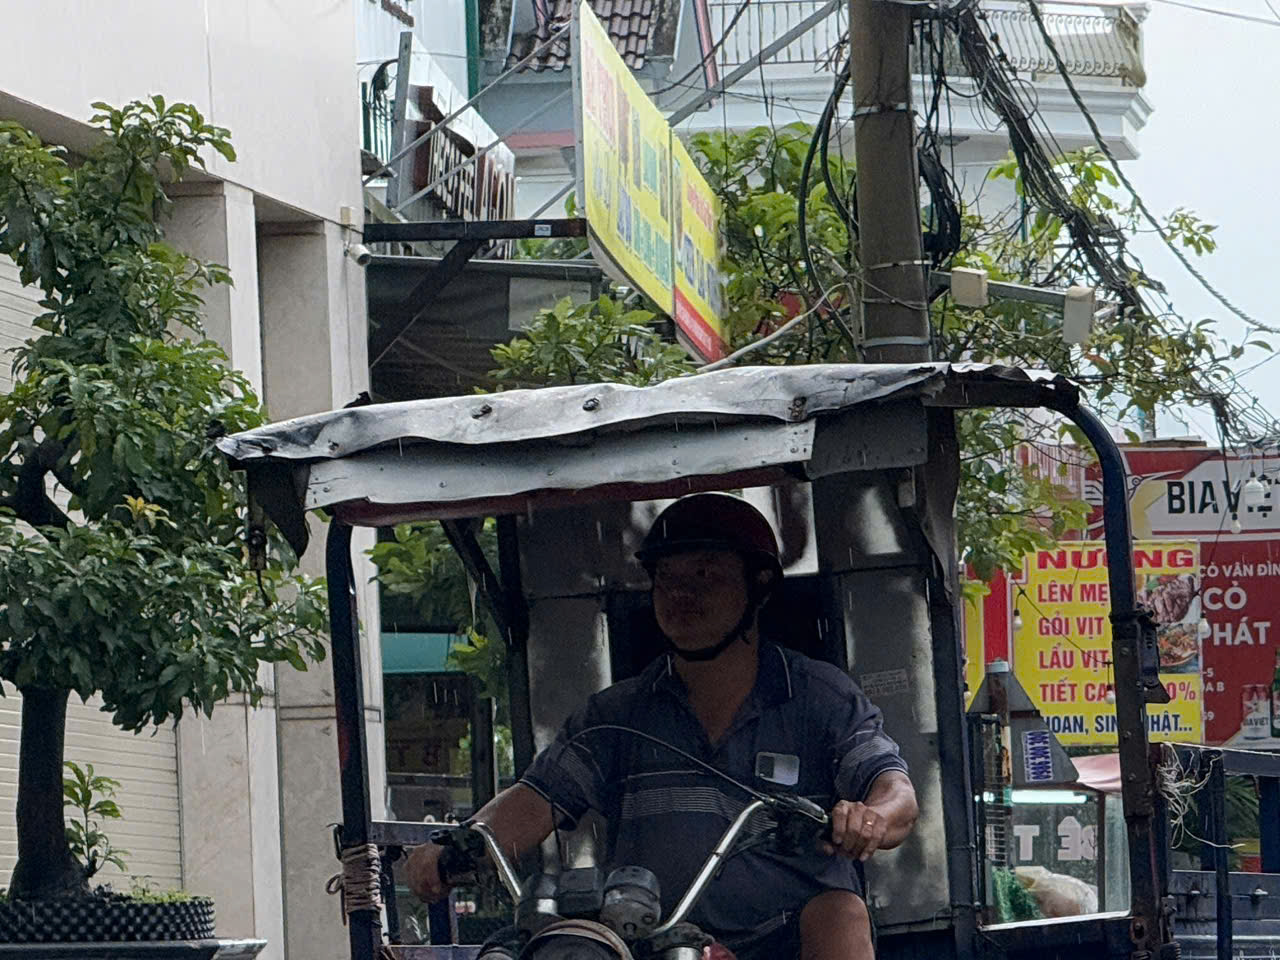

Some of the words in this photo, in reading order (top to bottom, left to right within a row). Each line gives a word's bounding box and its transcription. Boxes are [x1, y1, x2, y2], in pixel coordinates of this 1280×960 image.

[1167, 480, 1219, 514] BIA
[1038, 548, 1194, 570] NƯNG
[1222, 562, 1254, 577] VÂN
[1038, 580, 1073, 603] LÊN
[1077, 617, 1105, 639] VỊT
[1082, 651, 1112, 673] VỊT
[1040, 676, 1077, 702] TIẾT
[1095, 716, 1118, 733] SIN
